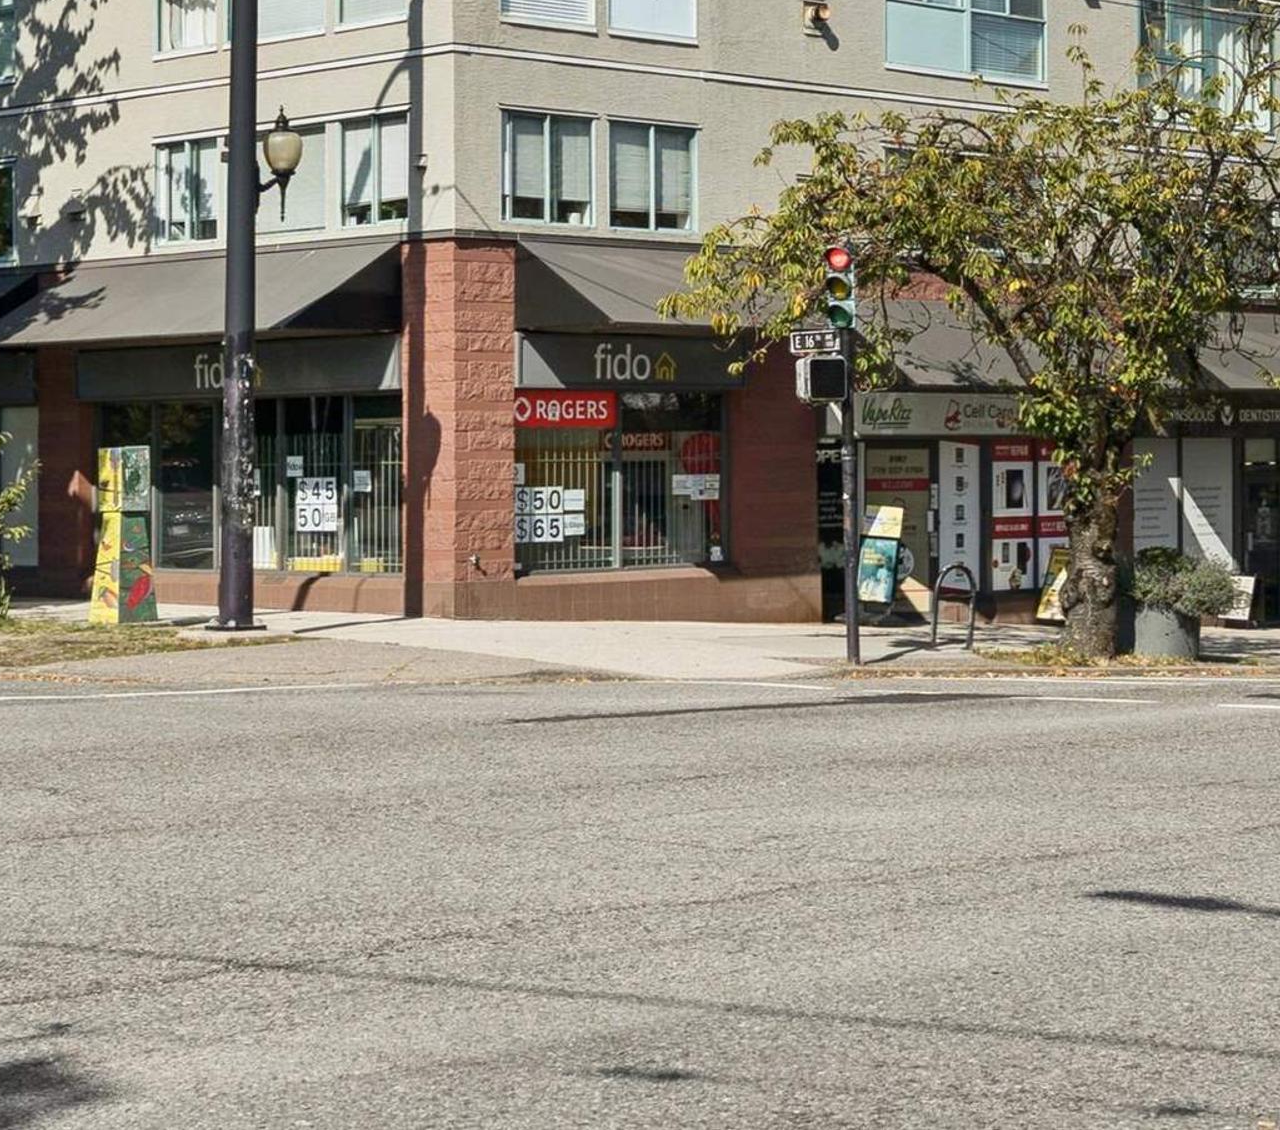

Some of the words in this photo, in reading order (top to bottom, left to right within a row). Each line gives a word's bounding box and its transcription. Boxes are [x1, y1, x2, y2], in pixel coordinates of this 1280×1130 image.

[795, 336, 802, 348] E
[805, 335, 815, 348] 16
[194, 353, 225, 389] fid
[593, 343, 651, 380] fido
[536, 400, 608, 421] ROGERS
[963, 404, 985, 419] Cell
[299, 480, 335, 501] $45
[517, 490, 561, 512] $50
[299, 508, 321, 527] 50
[517, 518, 561, 539] $65
